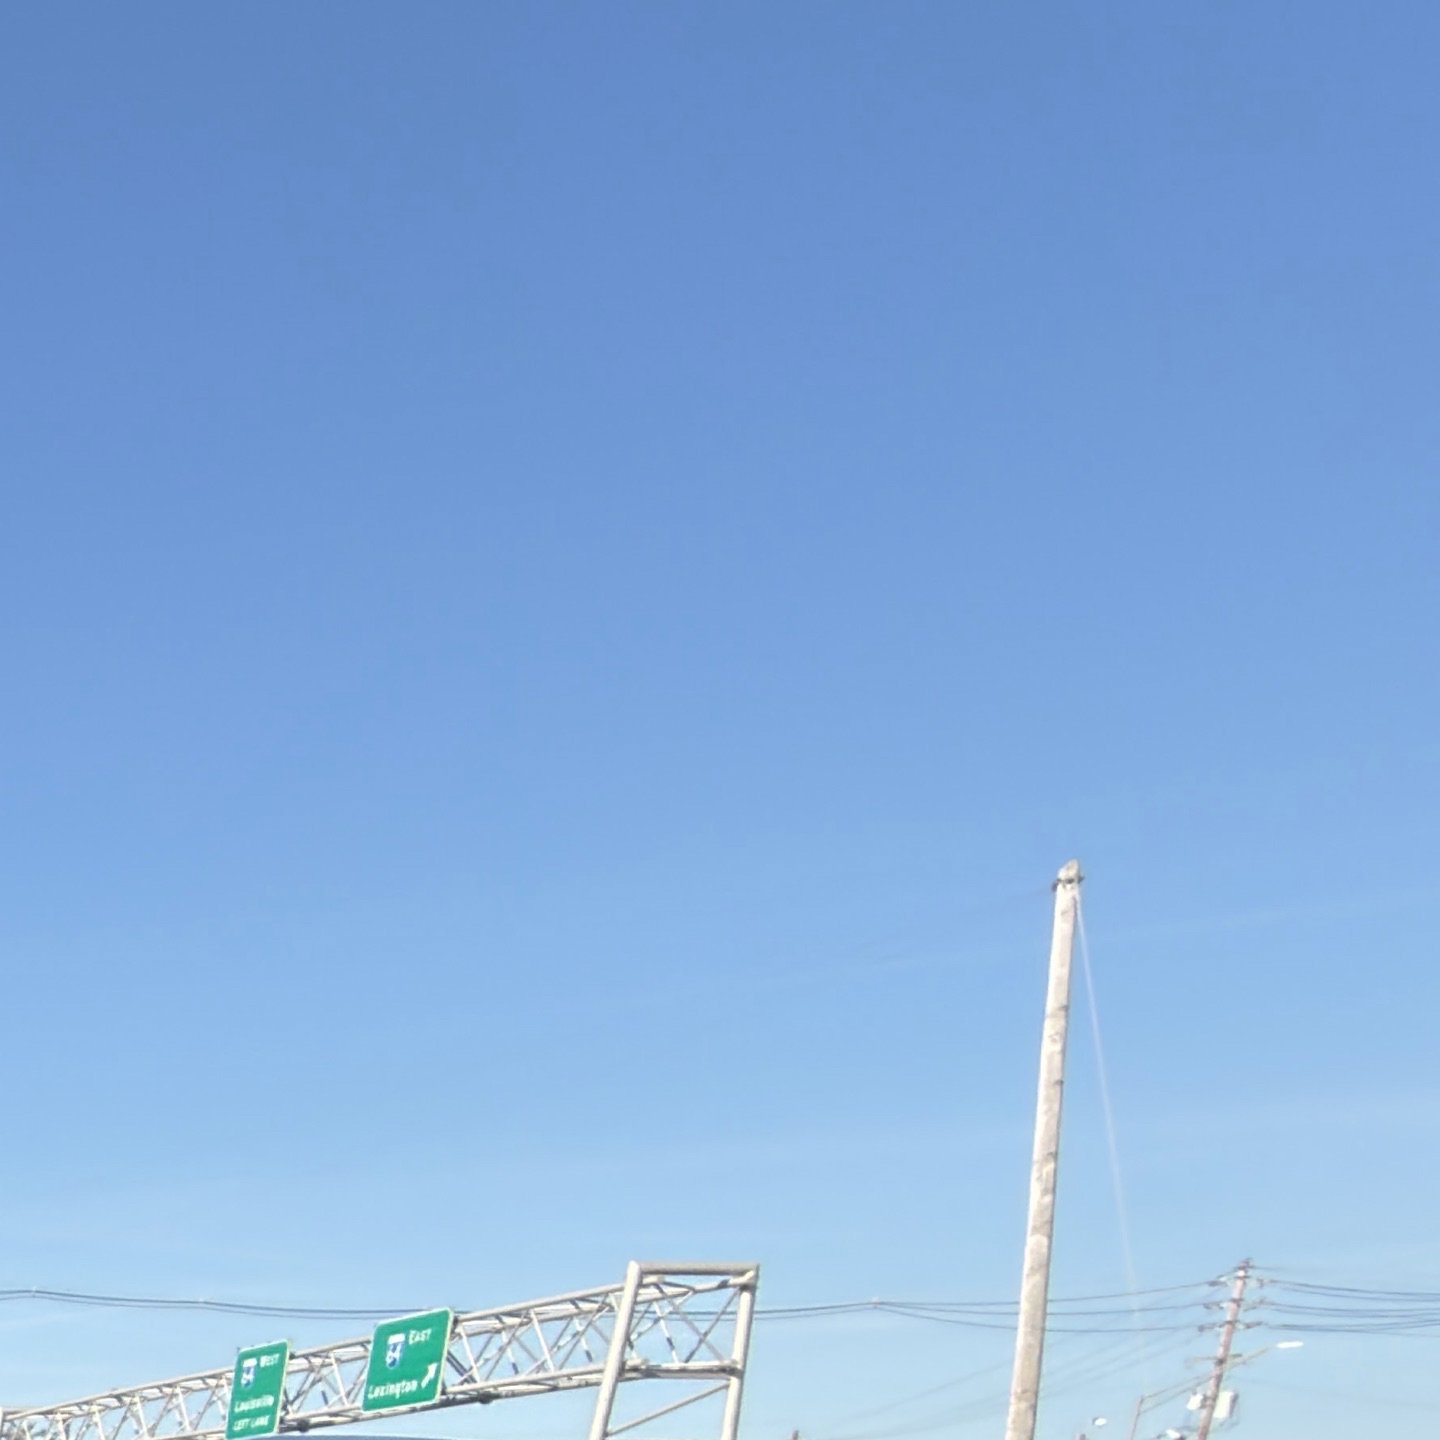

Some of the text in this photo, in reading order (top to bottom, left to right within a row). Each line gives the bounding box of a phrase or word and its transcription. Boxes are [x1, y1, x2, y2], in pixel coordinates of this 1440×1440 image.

[386, 1328, 432, 1362] 64 EAST
[367, 1379, 418, 1399] Lexington
